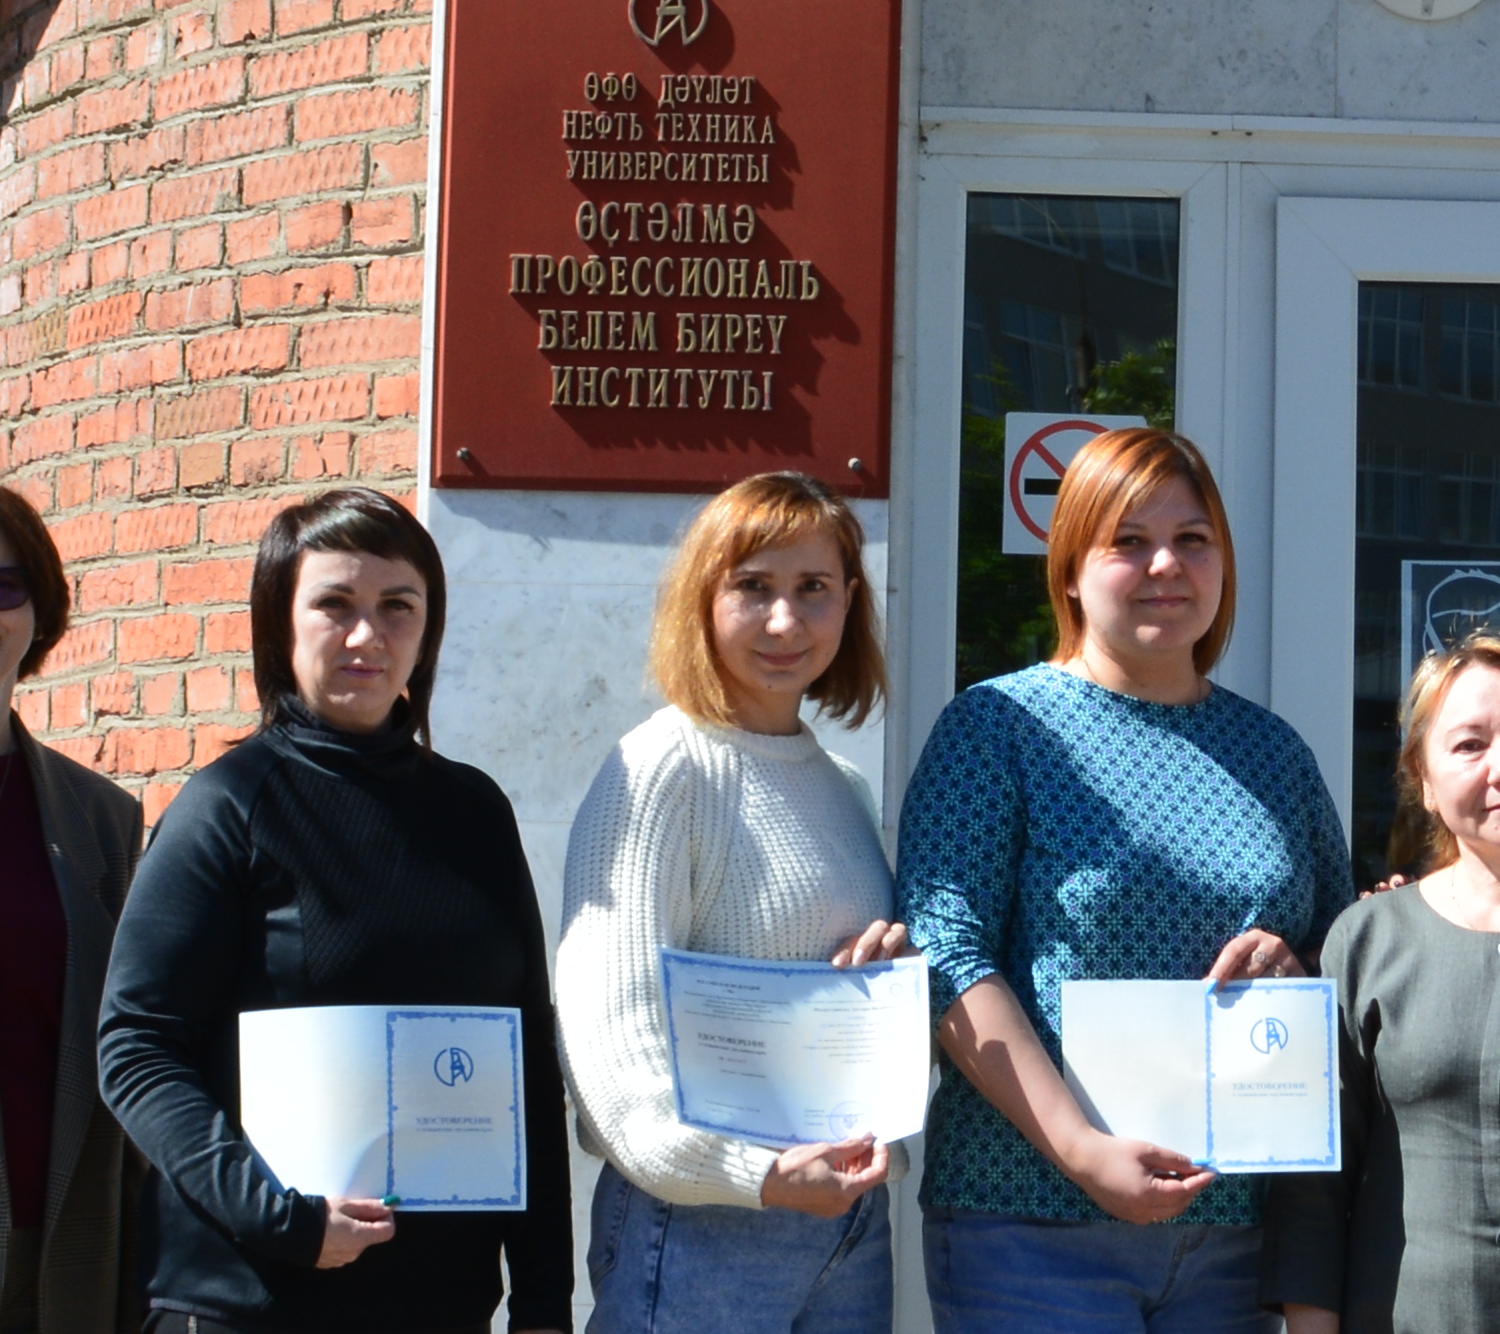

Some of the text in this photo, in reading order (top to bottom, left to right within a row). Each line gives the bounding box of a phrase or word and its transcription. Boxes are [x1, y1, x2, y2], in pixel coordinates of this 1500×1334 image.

[583, 71, 756, 109] ӨФӨ ДӘҮЛӘТ
[561, 109, 776, 145] НЕФТЬ ТЕХНИКА
[565, 149, 771, 184] УНИВЕРСИТЕТЫ
[508, 253, 820, 302] ПРОФЕССИОНАЛЬ
[537, 308, 659, 352] БЕЛЕМ
[549, 365, 774, 412] ИНСТИТУТЫ
